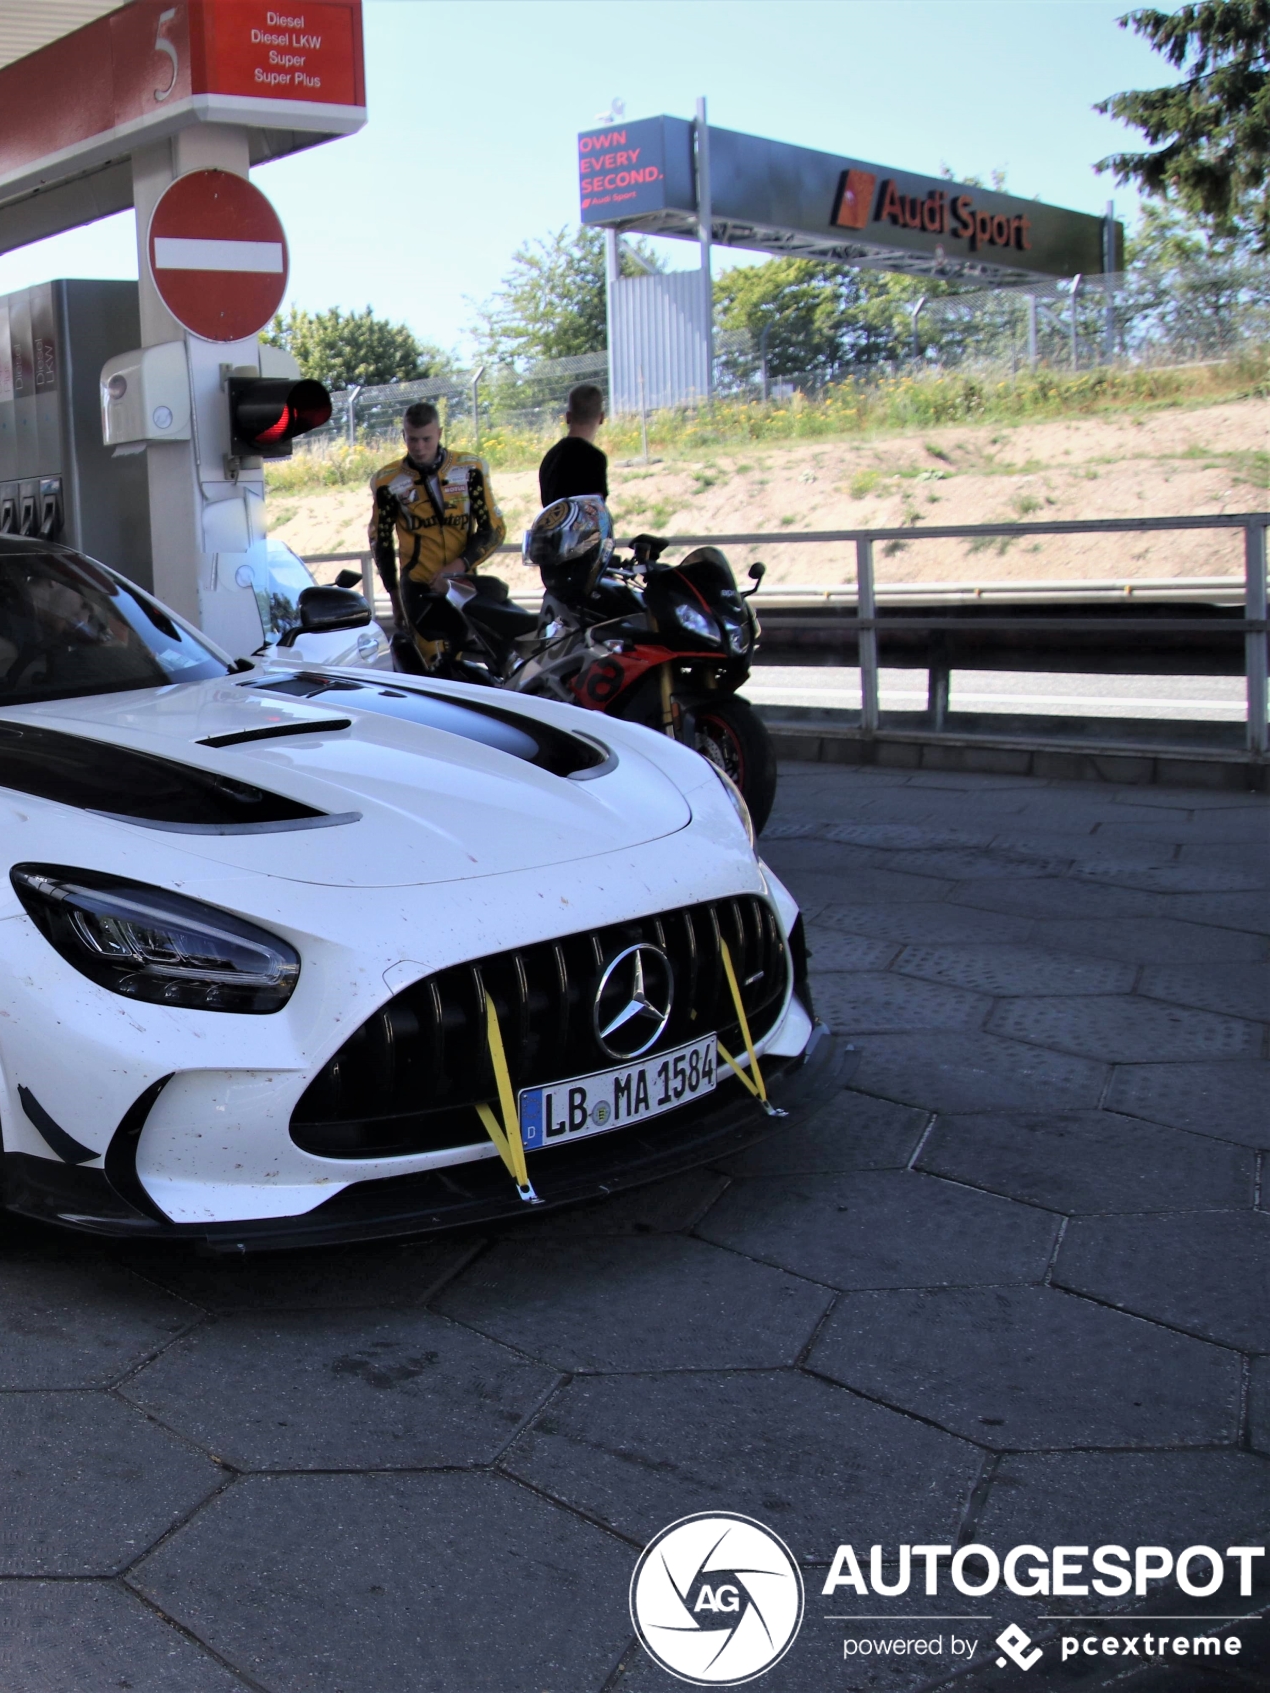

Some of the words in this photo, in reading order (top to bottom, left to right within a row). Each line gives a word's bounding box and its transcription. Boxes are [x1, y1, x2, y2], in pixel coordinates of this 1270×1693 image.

[266, 11, 305, 28] Diesel
[250, 29, 289, 46] Diesel
[292, 34, 322, 49] LKW
[154, 7, 179, 101] 5
[268, 50, 306, 67] Super
[254, 68, 291, 85] Super
[294, 72, 322, 88] Plus
[579, 130, 627, 153] OWN
[580, 147, 641, 174] EVERY
[581, 166, 664, 194] SECOND.
[877, 178, 950, 234] Audi
[954, 194, 1032, 250] Sport
[14, 343, 23, 391] Diesel
[34, 338, 44, 386] Diesel
[45, 344, 55, 384] LKW
[444, 485, 466, 493] MOTUL
[527, 1126, 536, 1139] D
[545, 1086, 588, 1138] LB
[614, 1068, 650, 1120] MA
[658, 1044, 713, 1106] 1584
